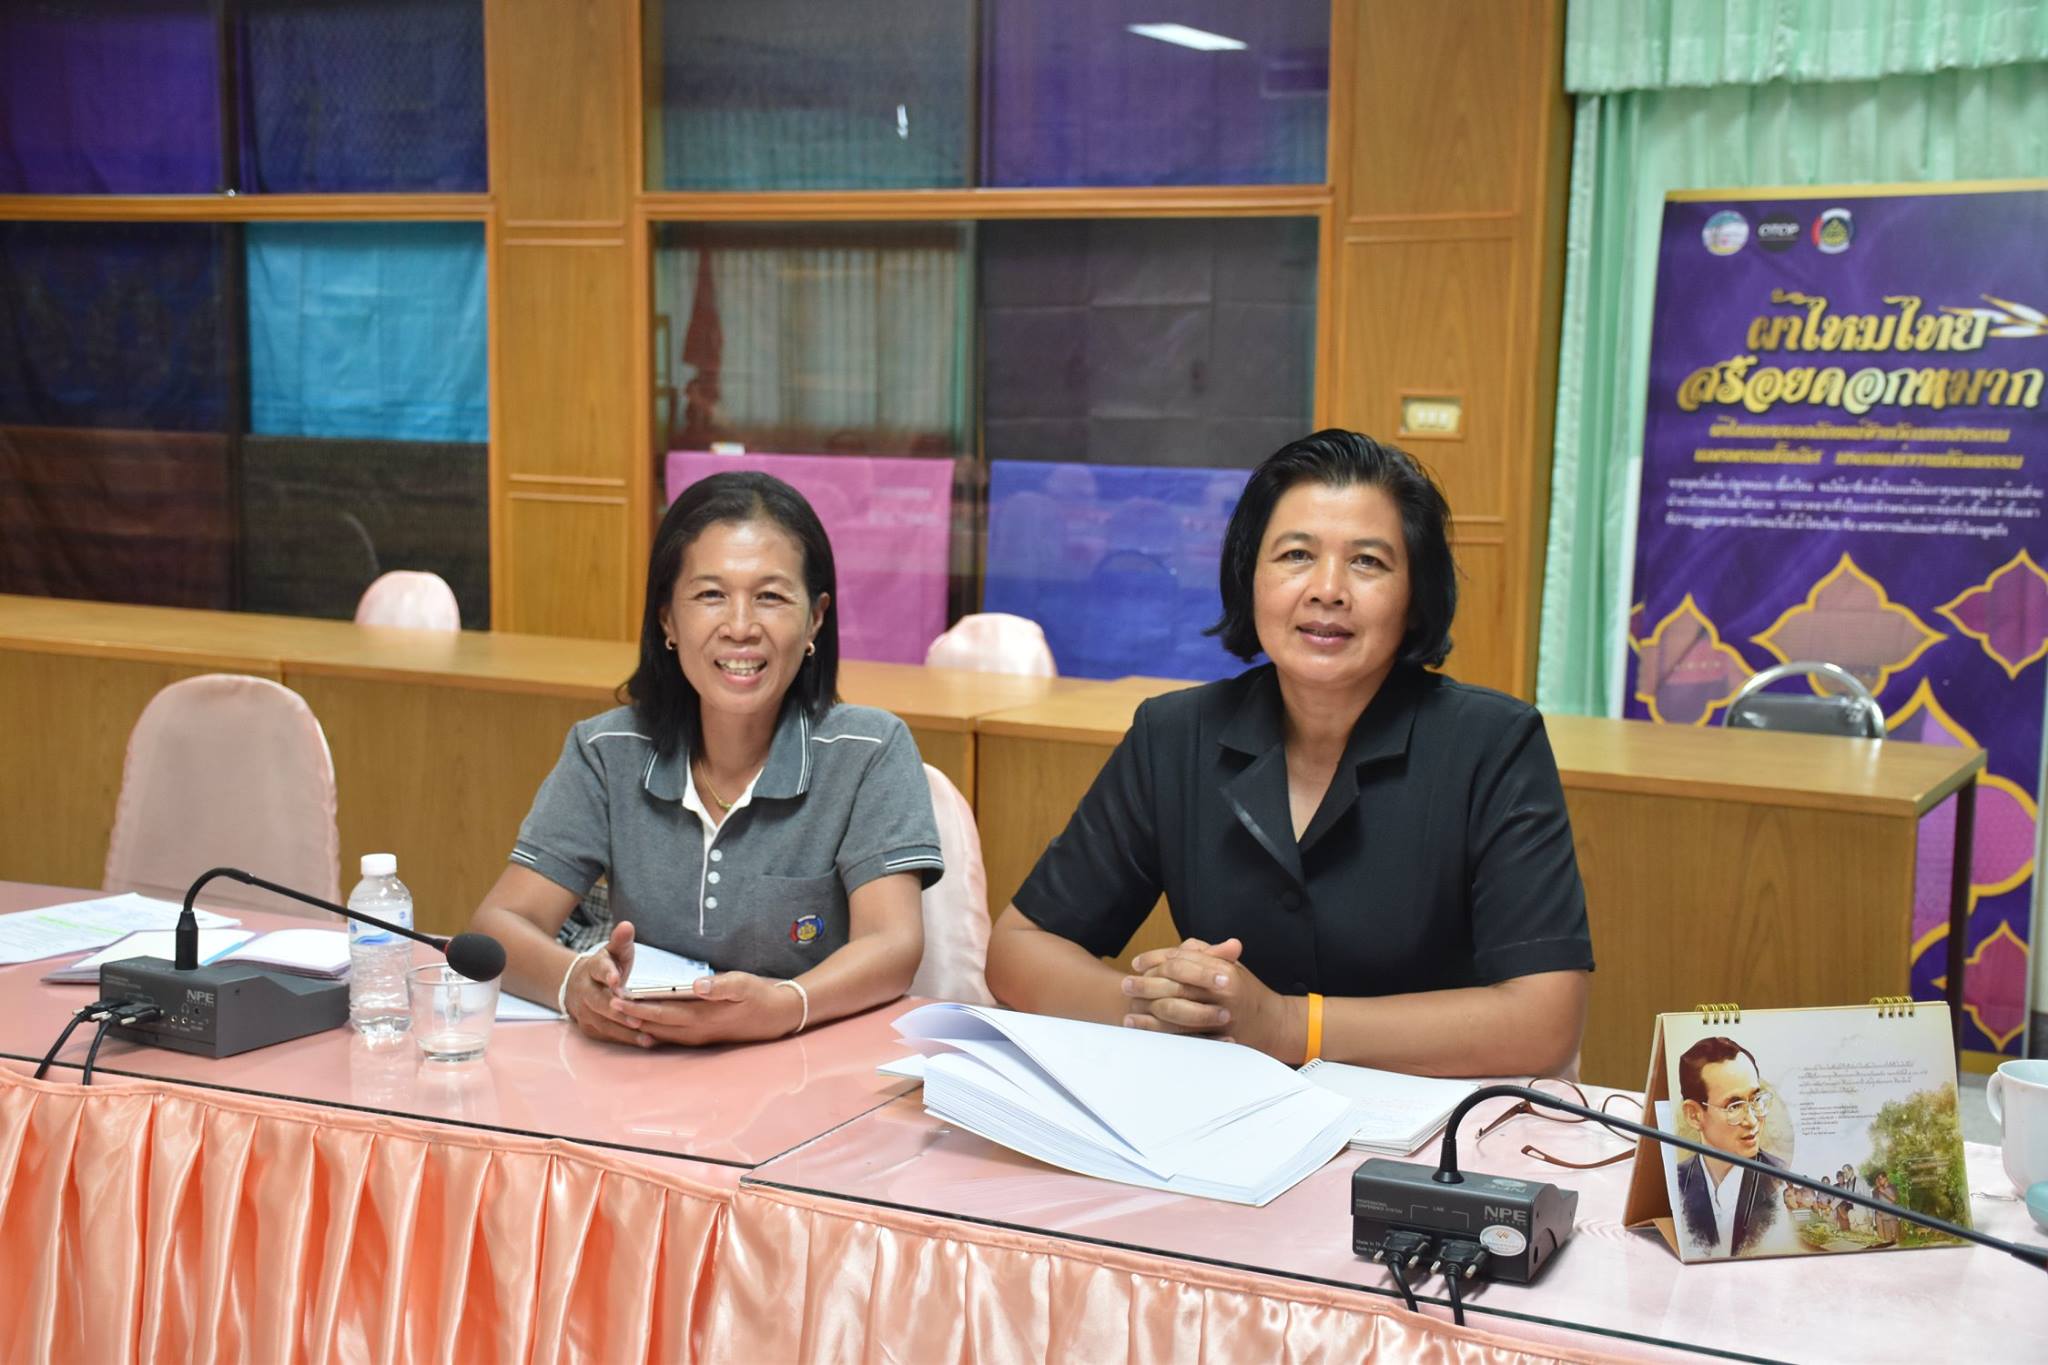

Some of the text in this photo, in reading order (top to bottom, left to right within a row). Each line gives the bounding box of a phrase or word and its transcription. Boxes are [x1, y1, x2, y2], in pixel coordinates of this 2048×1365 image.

[1746, 289, 1990, 352] ผ้าไหมไทย
[1677, 354, 2045, 414] สร้อยดอกหมาก
[186, 988, 215, 1004] NPE
[1484, 1205, 1527, 1222] NPE
